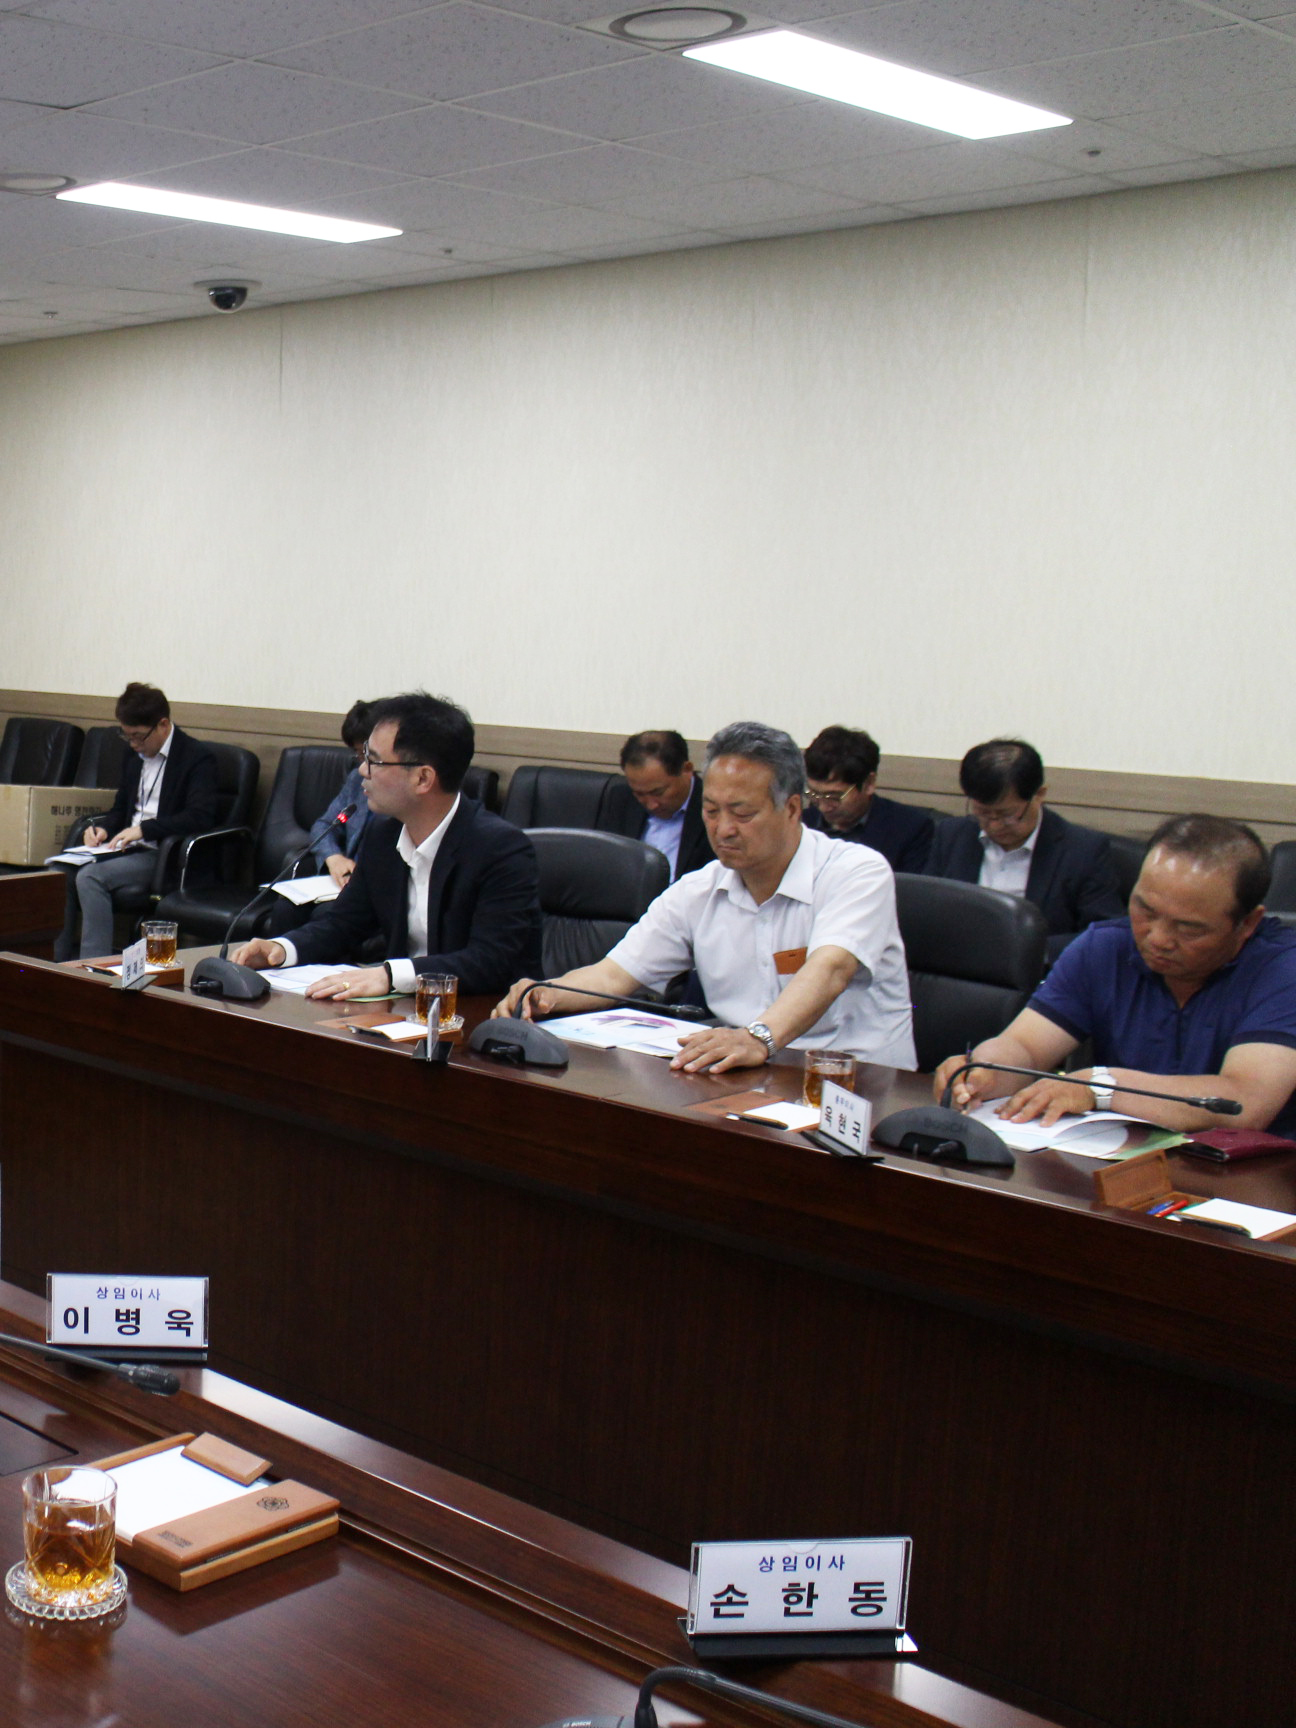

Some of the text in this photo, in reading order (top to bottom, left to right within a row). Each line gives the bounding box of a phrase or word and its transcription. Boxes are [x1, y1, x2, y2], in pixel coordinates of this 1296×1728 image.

[96, 1286, 161, 1301] 상임이사
[63, 1306, 194, 1338] 이병욱
[758, 1554, 846, 1573] 상임이사
[710, 1581, 888, 1619] 손한동
